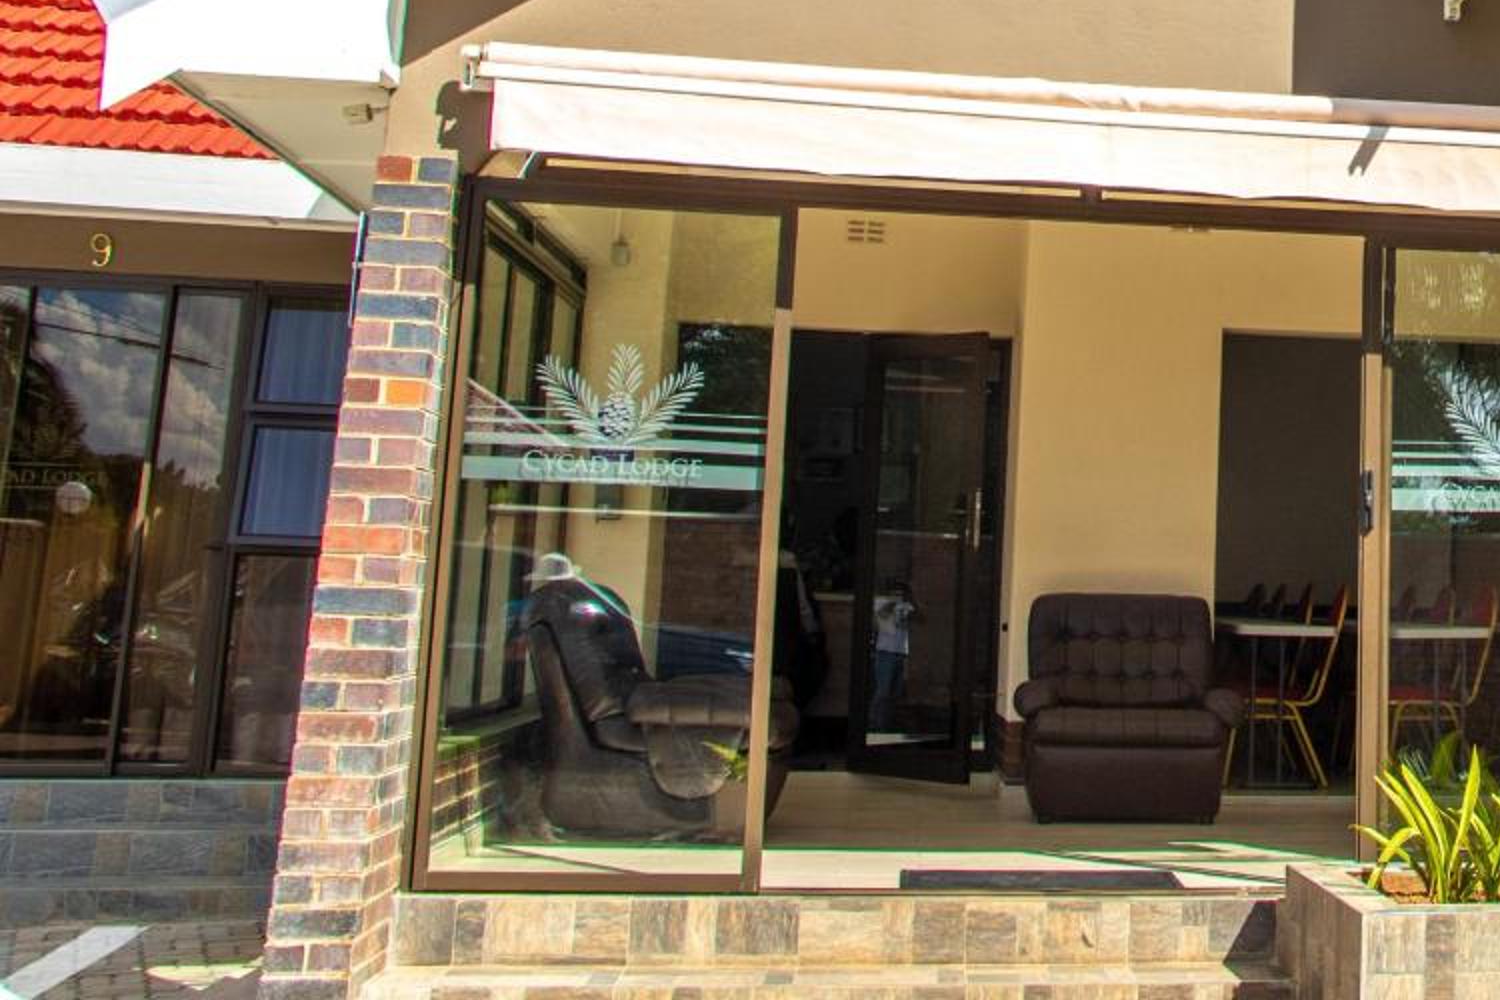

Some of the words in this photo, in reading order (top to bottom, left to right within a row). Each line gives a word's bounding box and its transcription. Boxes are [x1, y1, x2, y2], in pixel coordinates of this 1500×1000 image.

[91, 233, 112, 267] 9
[522, 449, 609, 475] CYCAD
[619, 453, 703, 479] LODGE
